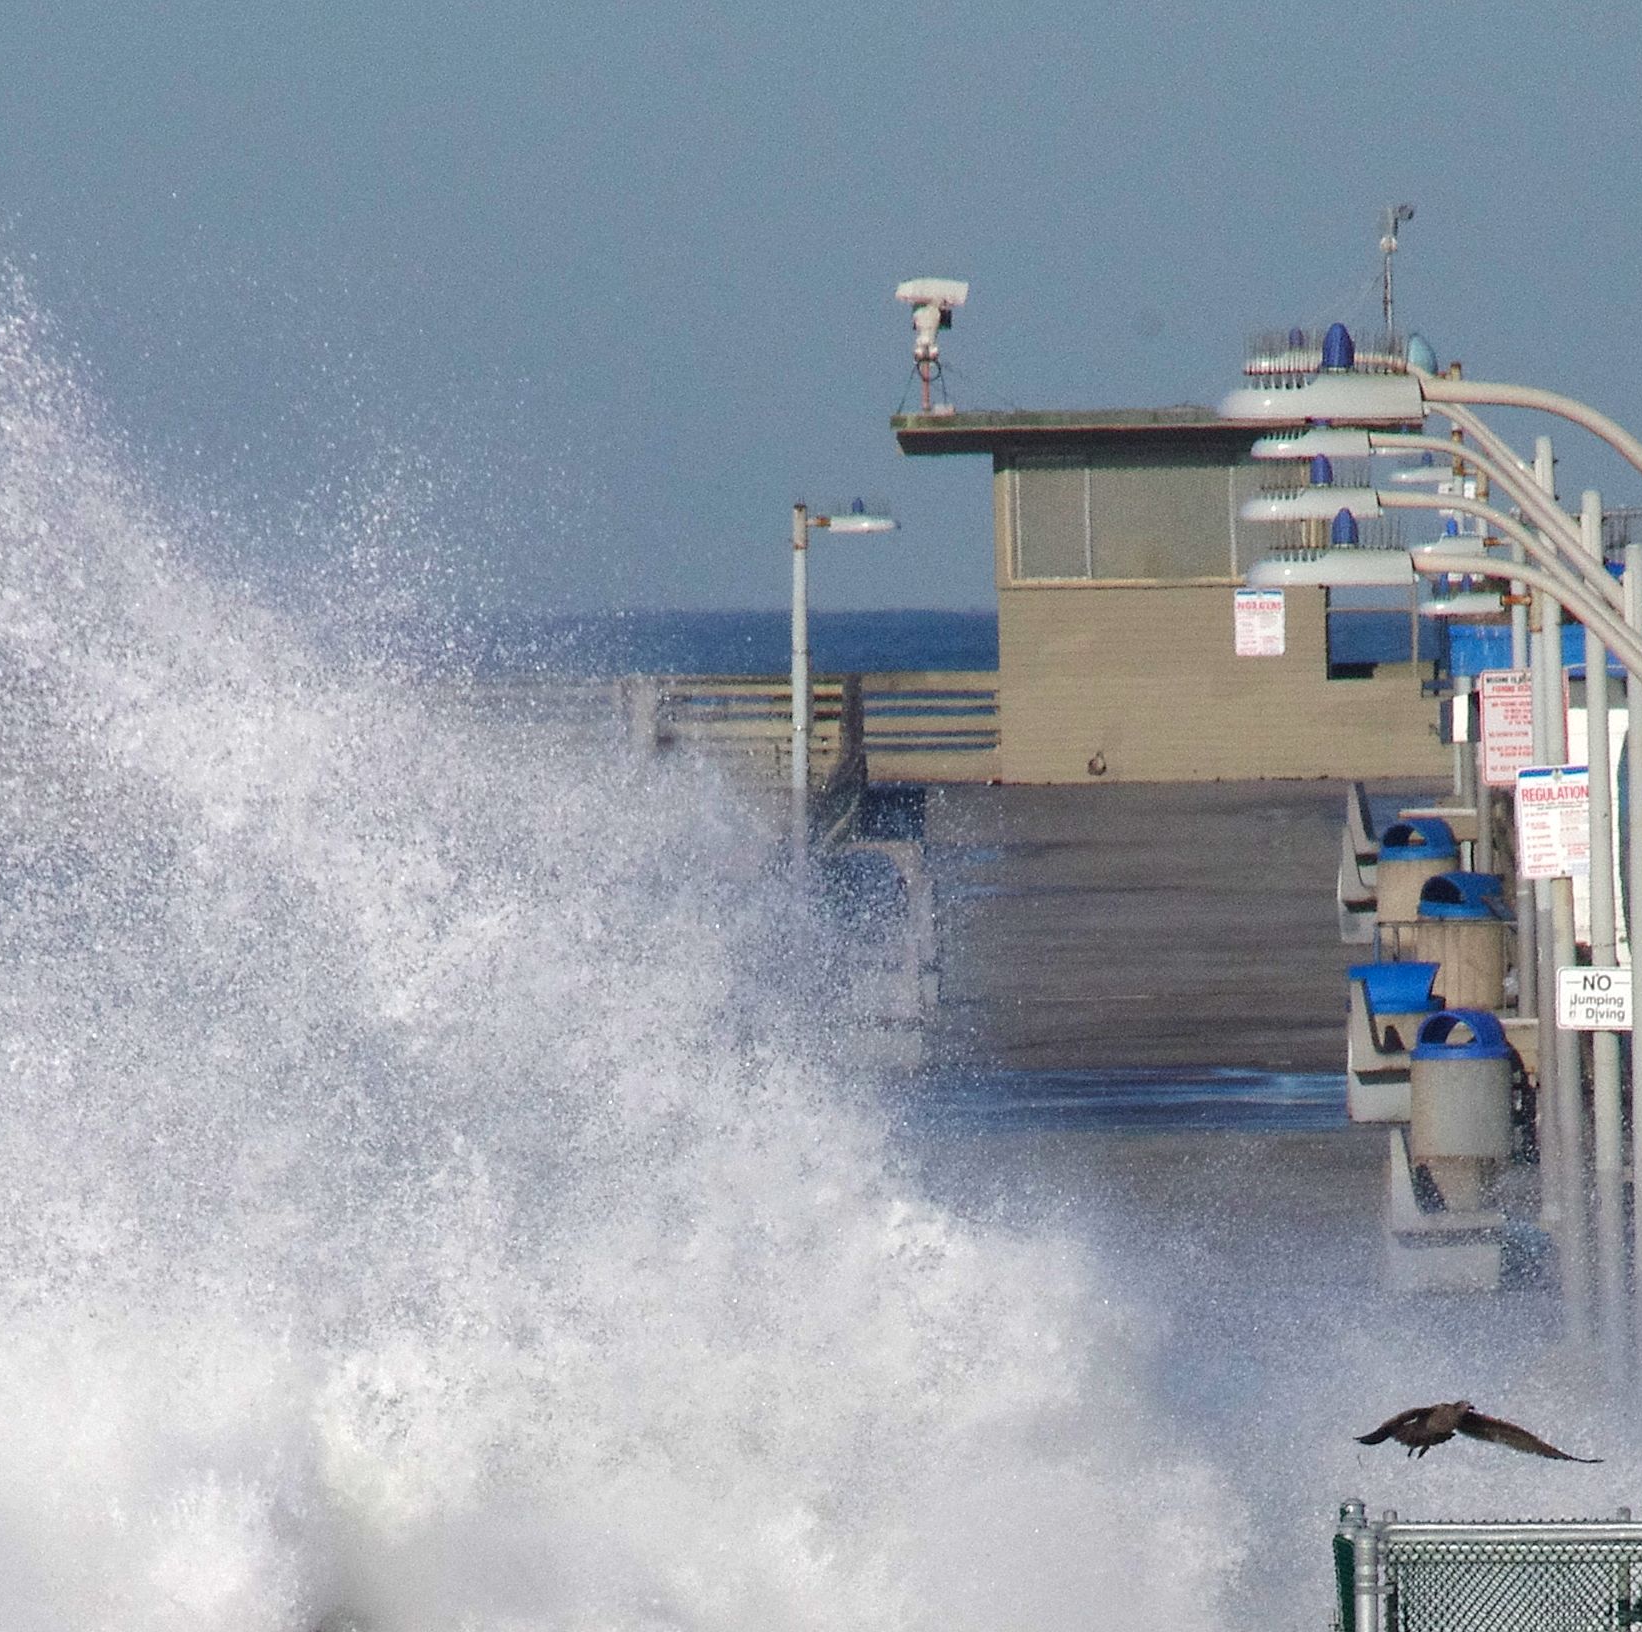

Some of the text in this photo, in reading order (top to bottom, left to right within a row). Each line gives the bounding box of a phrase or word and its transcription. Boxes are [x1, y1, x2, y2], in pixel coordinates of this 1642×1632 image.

[1583, 975, 1611, 991] NO
[1570, 993, 1624, 1007] Jumping
[1586, 1008, 1625, 1022] Diving
